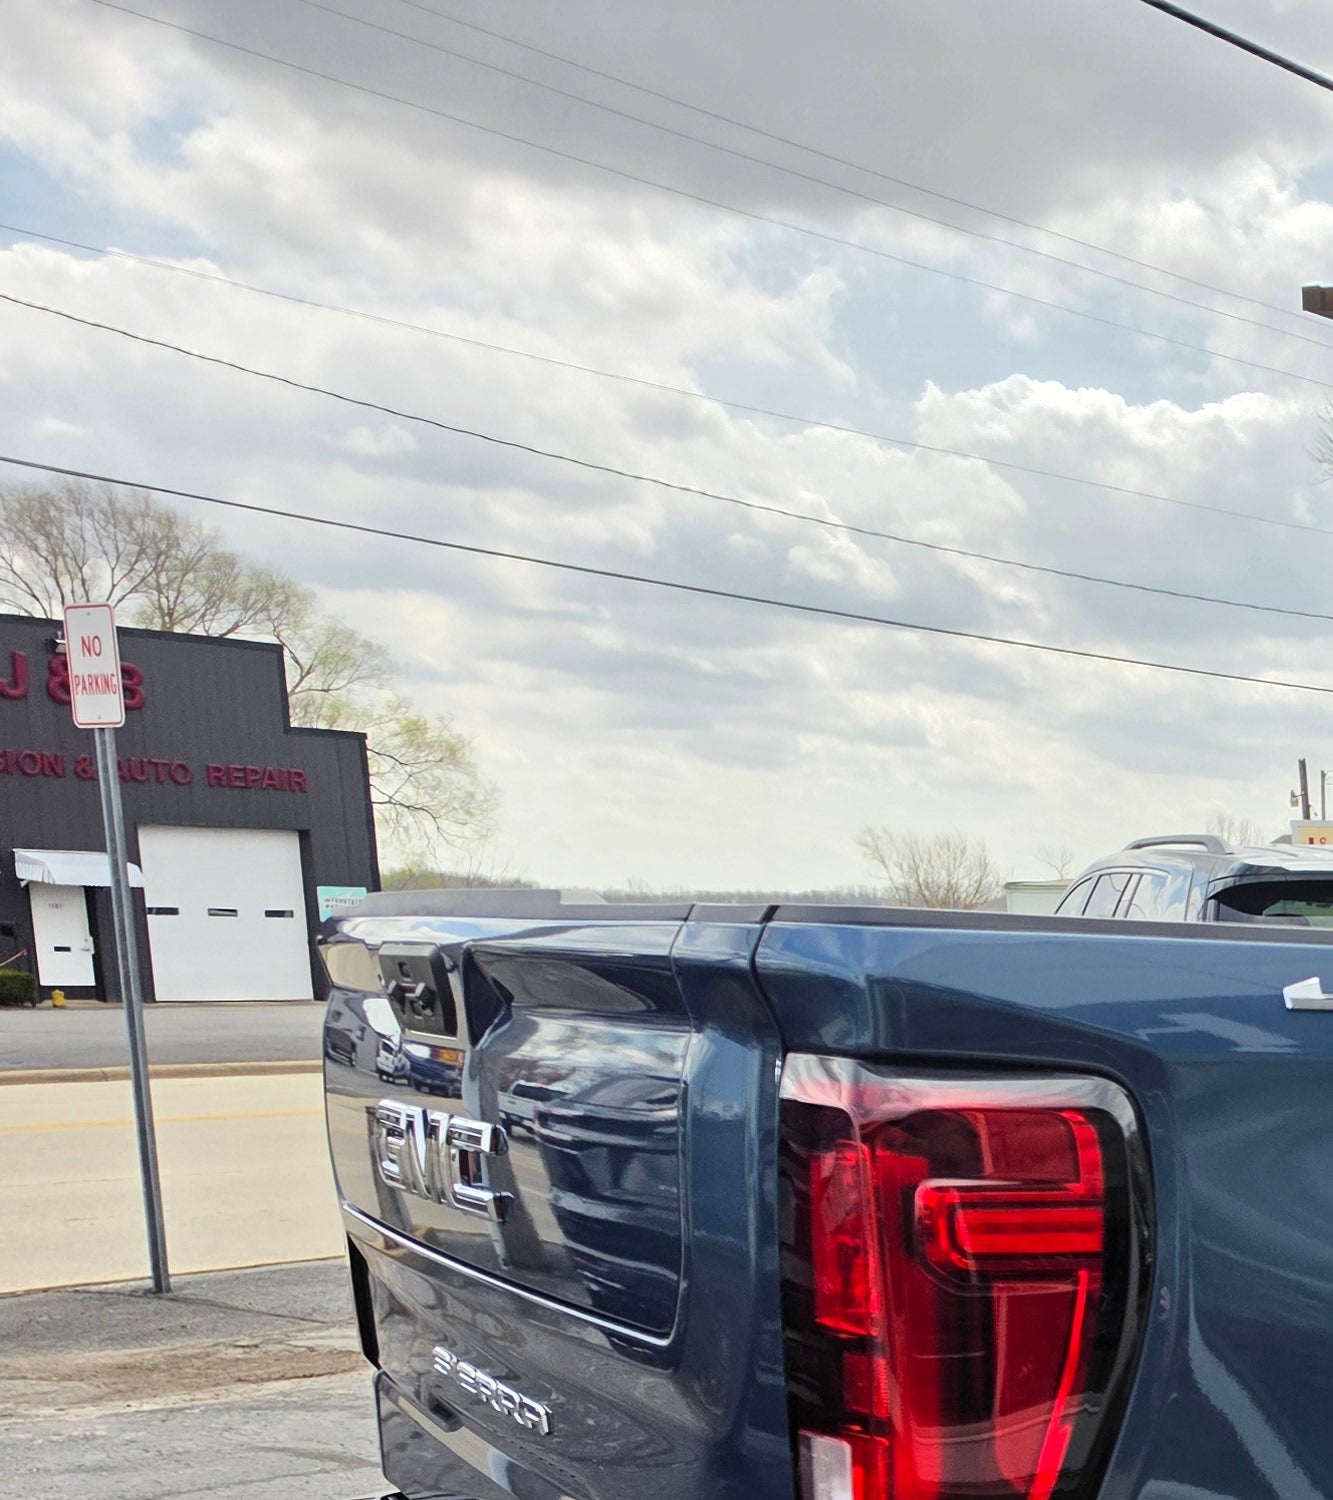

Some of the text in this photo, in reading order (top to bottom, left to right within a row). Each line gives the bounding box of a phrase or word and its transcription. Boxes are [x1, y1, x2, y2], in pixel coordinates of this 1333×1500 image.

[81, 635, 102, 657] NO
[0, 650, 28, 699] J
[74, 673, 117, 696] PARKING
[74, 754, 98, 780] &
[205, 763, 308, 793] REPAIR
[375, 1099, 503, 1222] GMC
[432, 1346, 552, 1436] SIERRA
